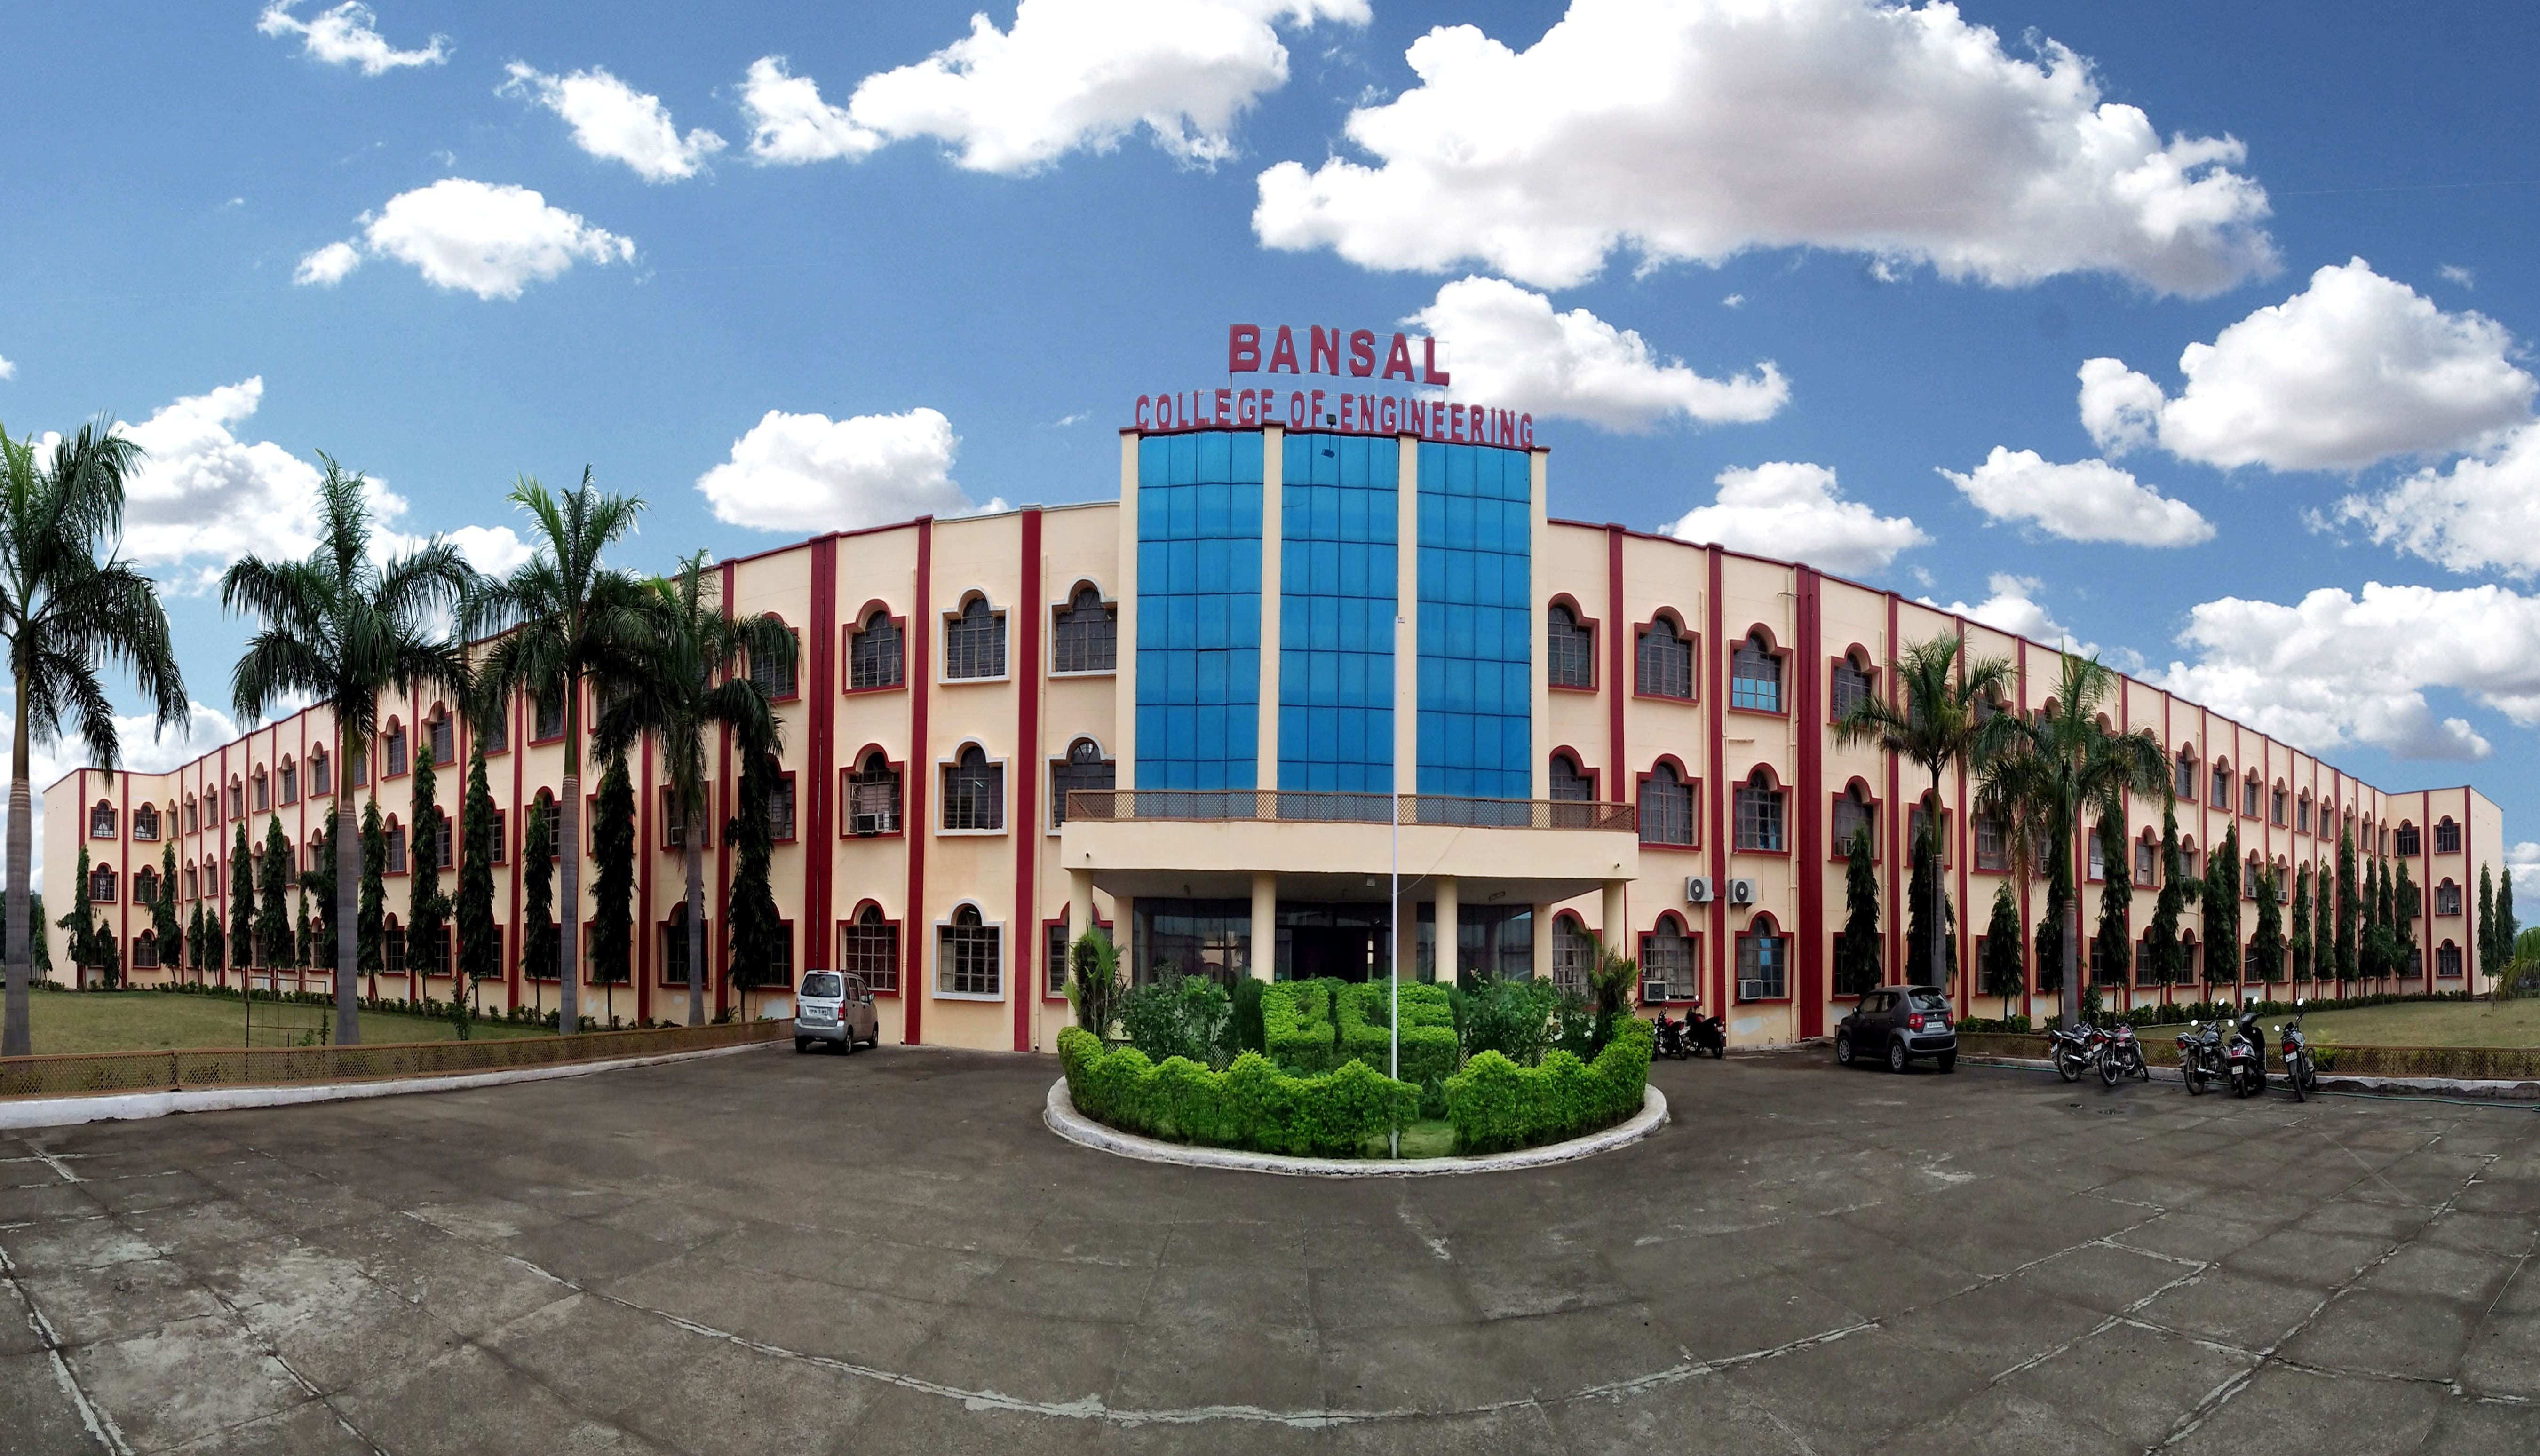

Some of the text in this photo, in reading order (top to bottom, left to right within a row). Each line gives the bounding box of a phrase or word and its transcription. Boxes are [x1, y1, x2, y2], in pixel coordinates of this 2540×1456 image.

[1230, 324, 1449, 386] BANSAL
[1135, 388, 1533, 448] COLLEGE OF ENGINEERING
